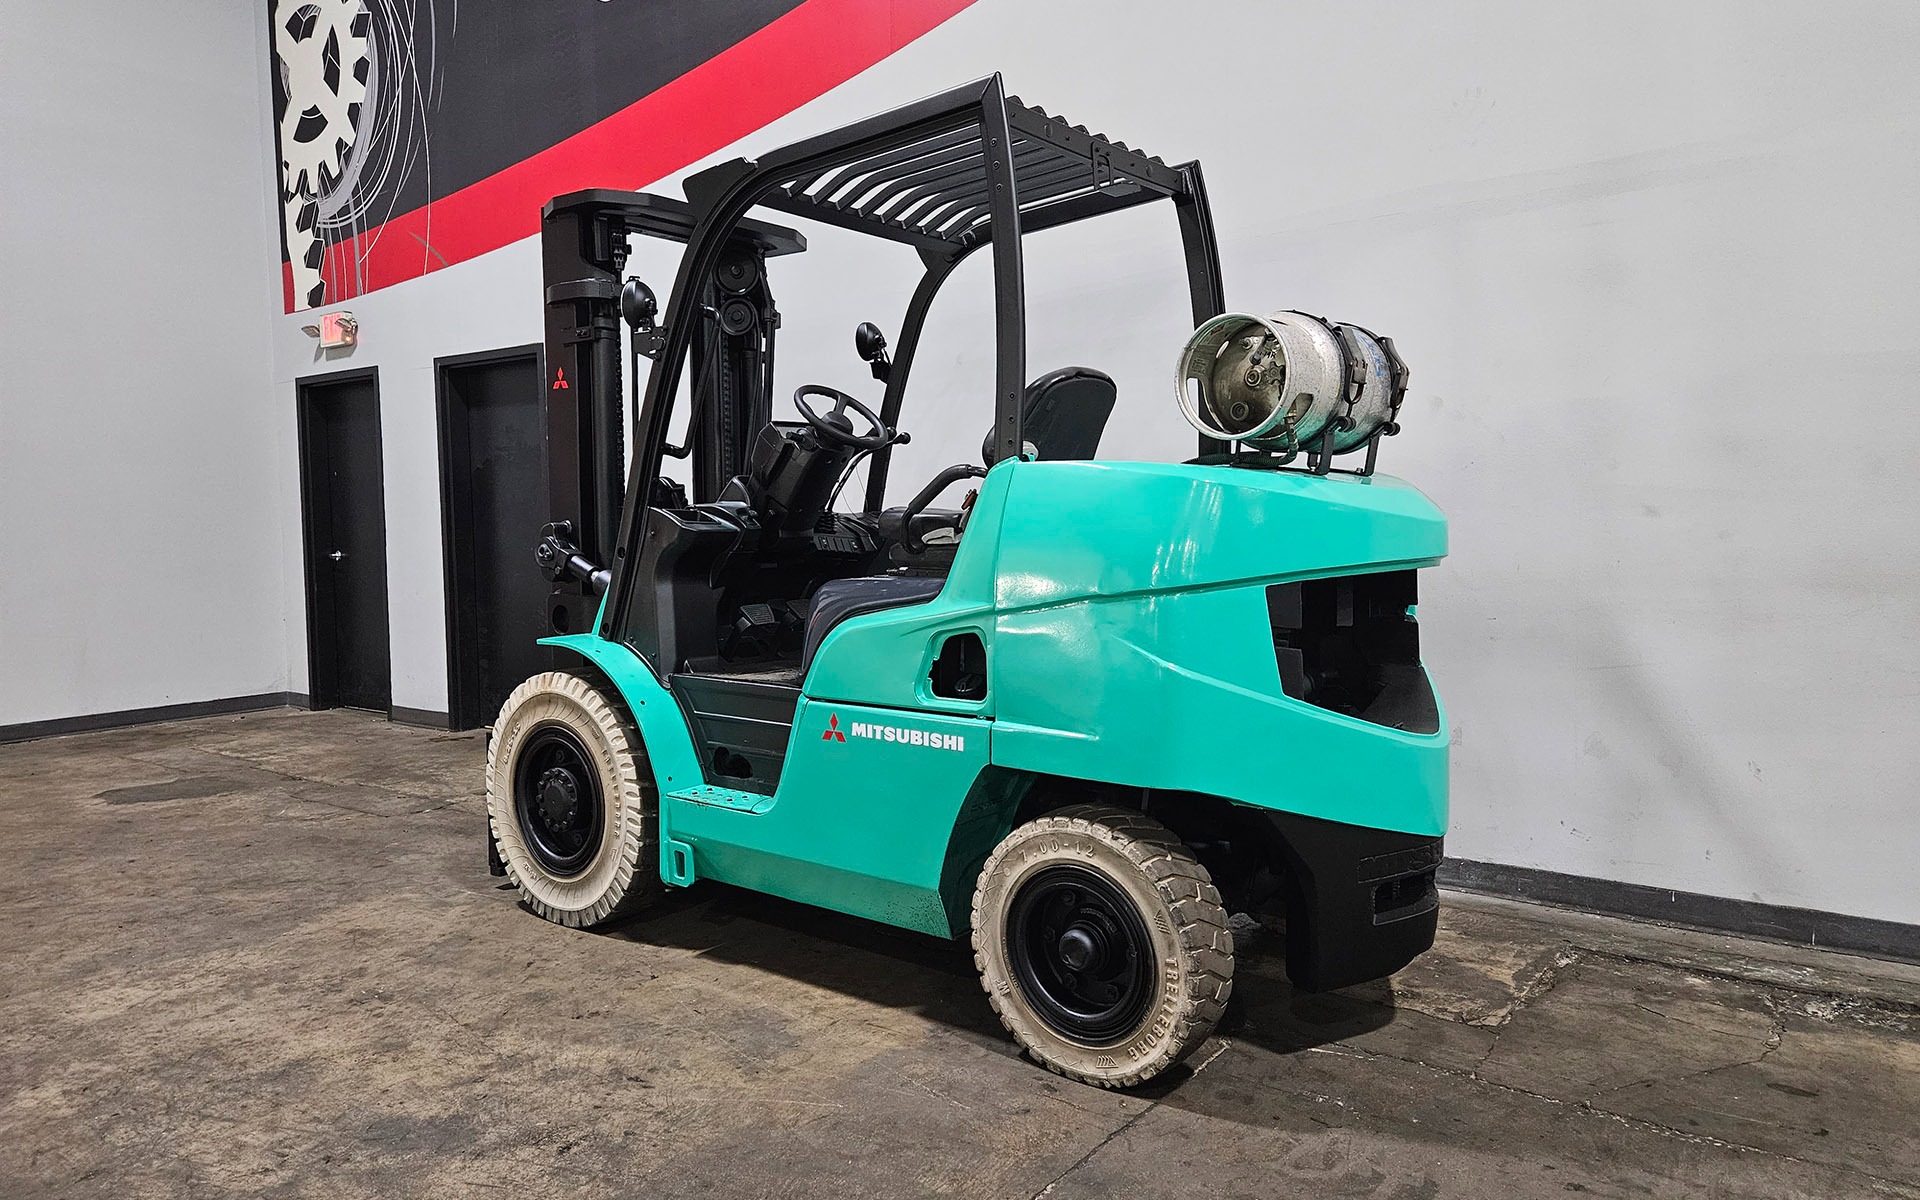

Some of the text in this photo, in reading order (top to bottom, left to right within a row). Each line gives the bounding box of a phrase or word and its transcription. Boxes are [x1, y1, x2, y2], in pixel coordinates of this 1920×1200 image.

[851, 722, 964, 752] MITSUBISHI
[1018, 840, 1096, 862] 7.00-12
[1127, 958, 1179, 1061] TRELLEBORG
